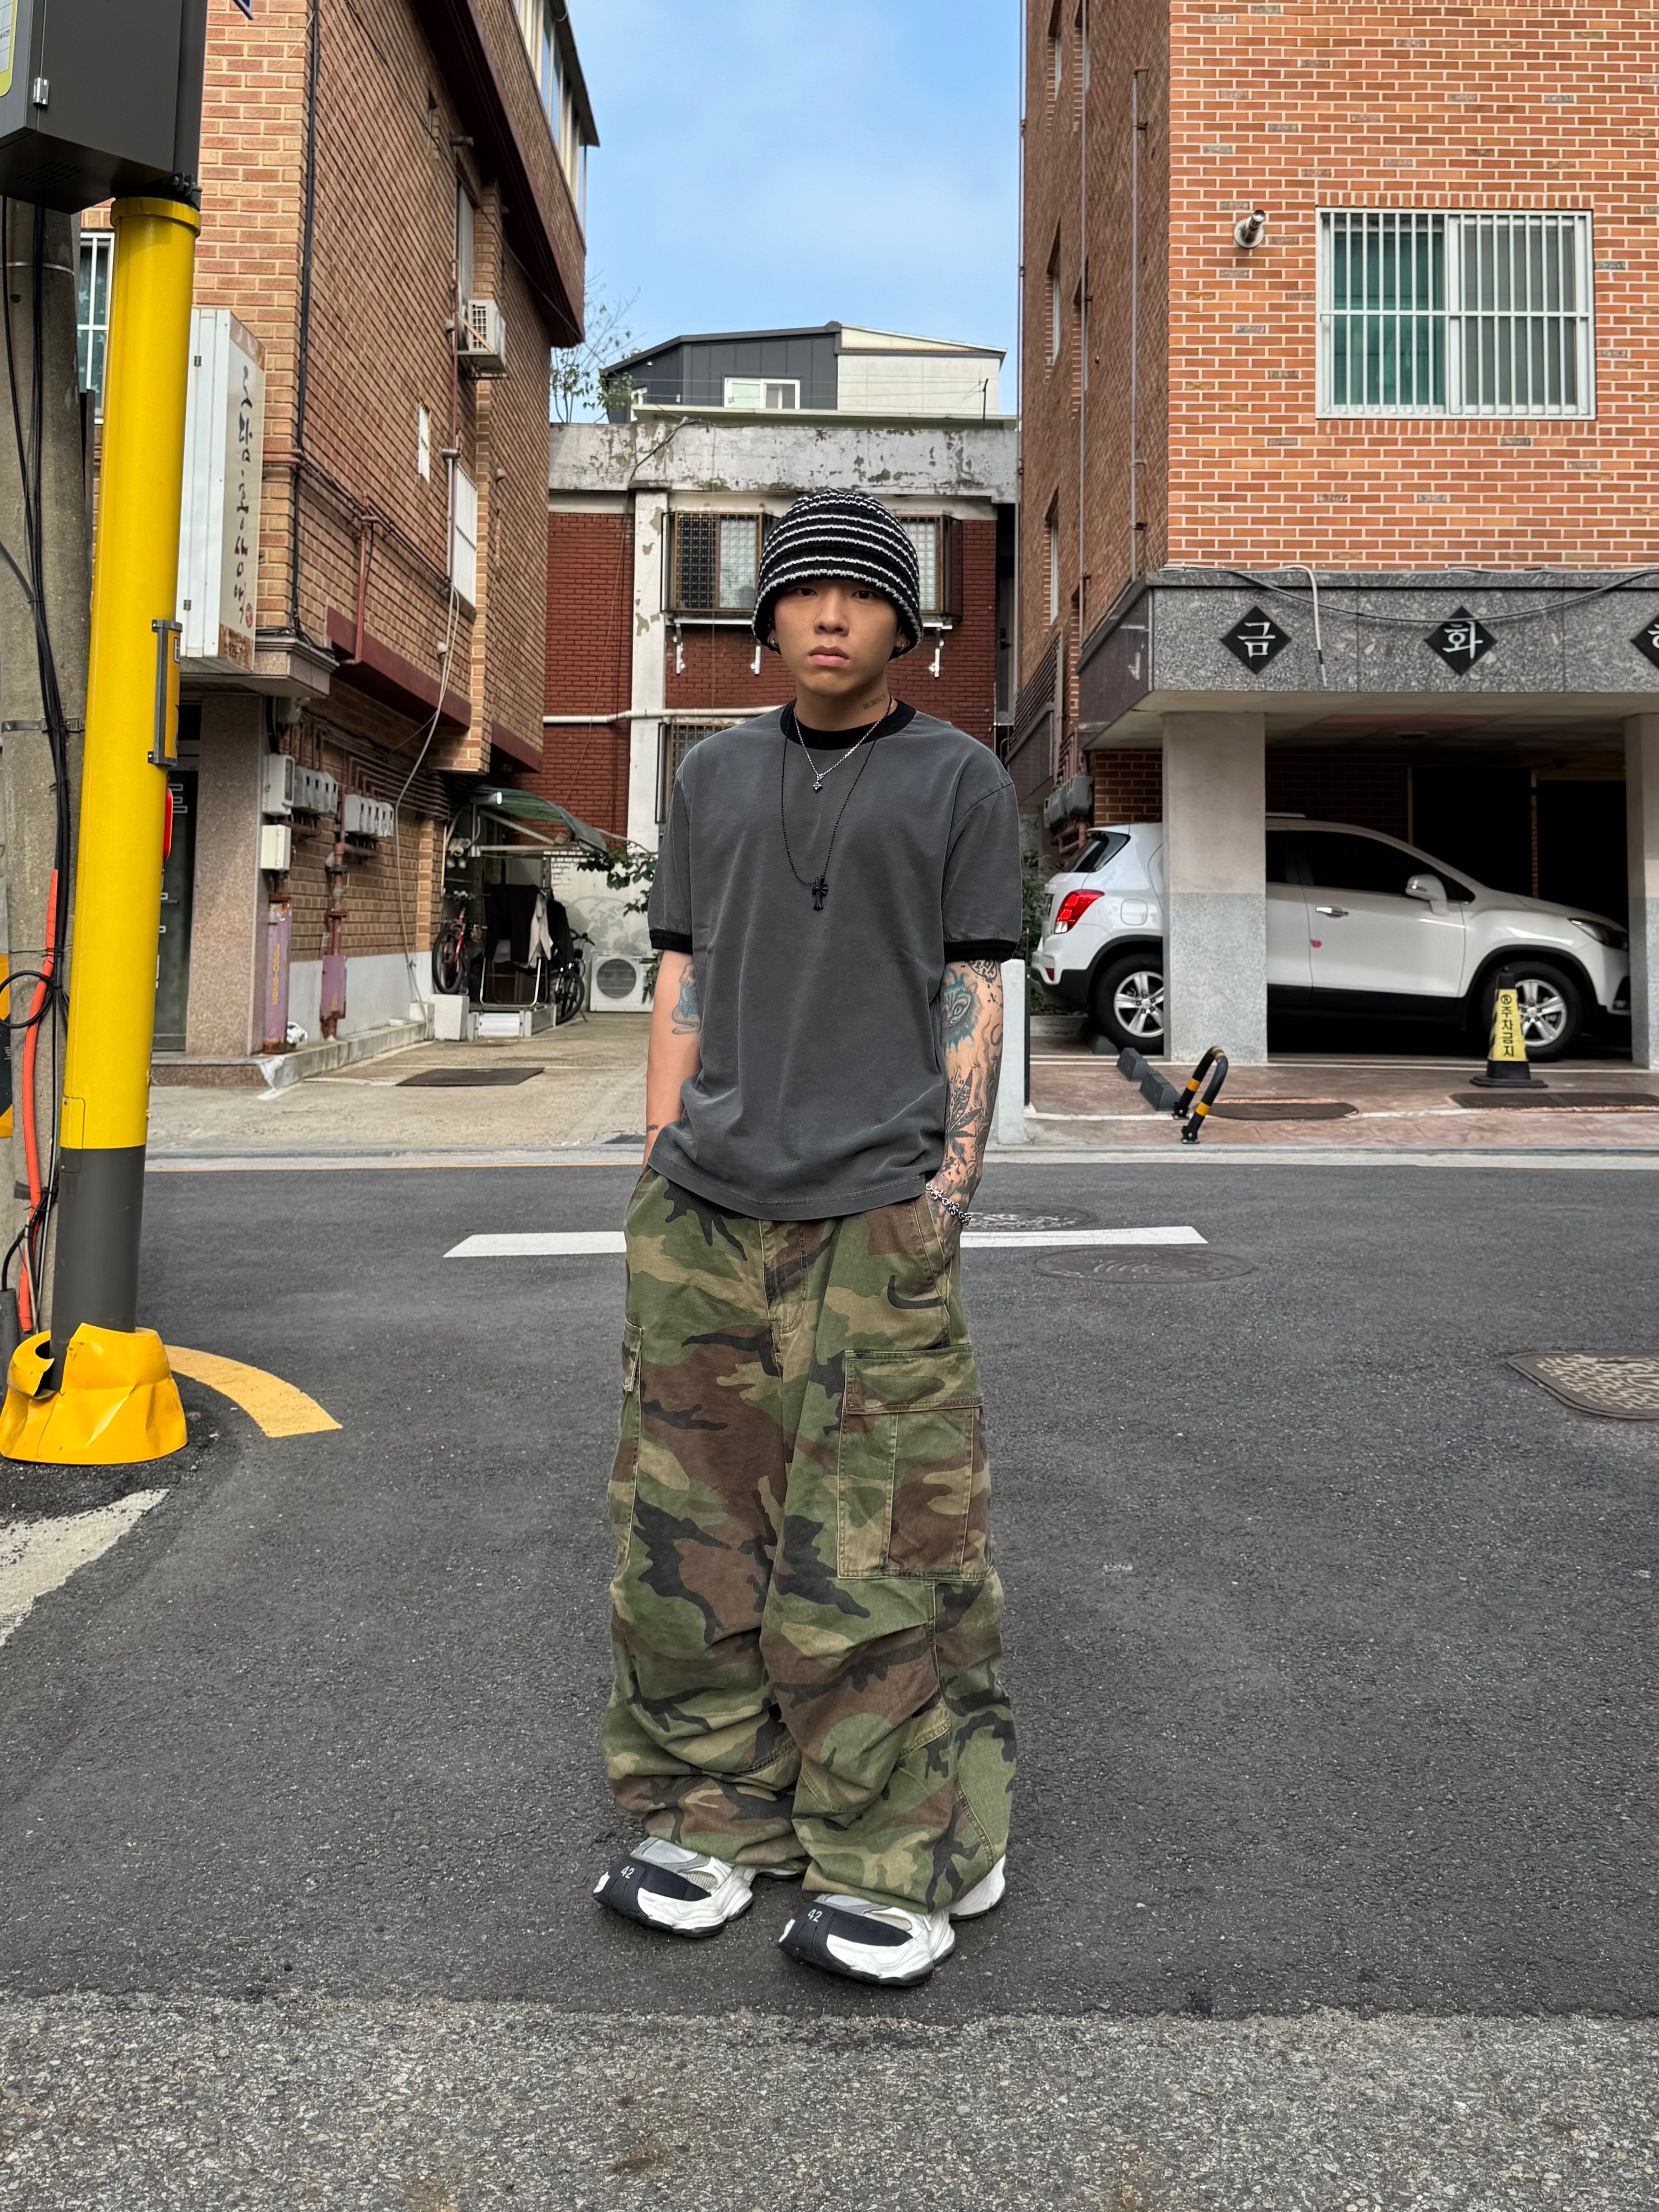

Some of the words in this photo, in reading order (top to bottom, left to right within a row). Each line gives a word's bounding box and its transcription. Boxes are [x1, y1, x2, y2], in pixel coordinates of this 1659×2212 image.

[1237, 622, 1276, 657] 금
[1442, 621, 1484, 659] 화
[1501, 1006, 1514, 1057] 주차금지
[621, 1865, 635, 1879] 42
[807, 1908, 823, 1923] 42
